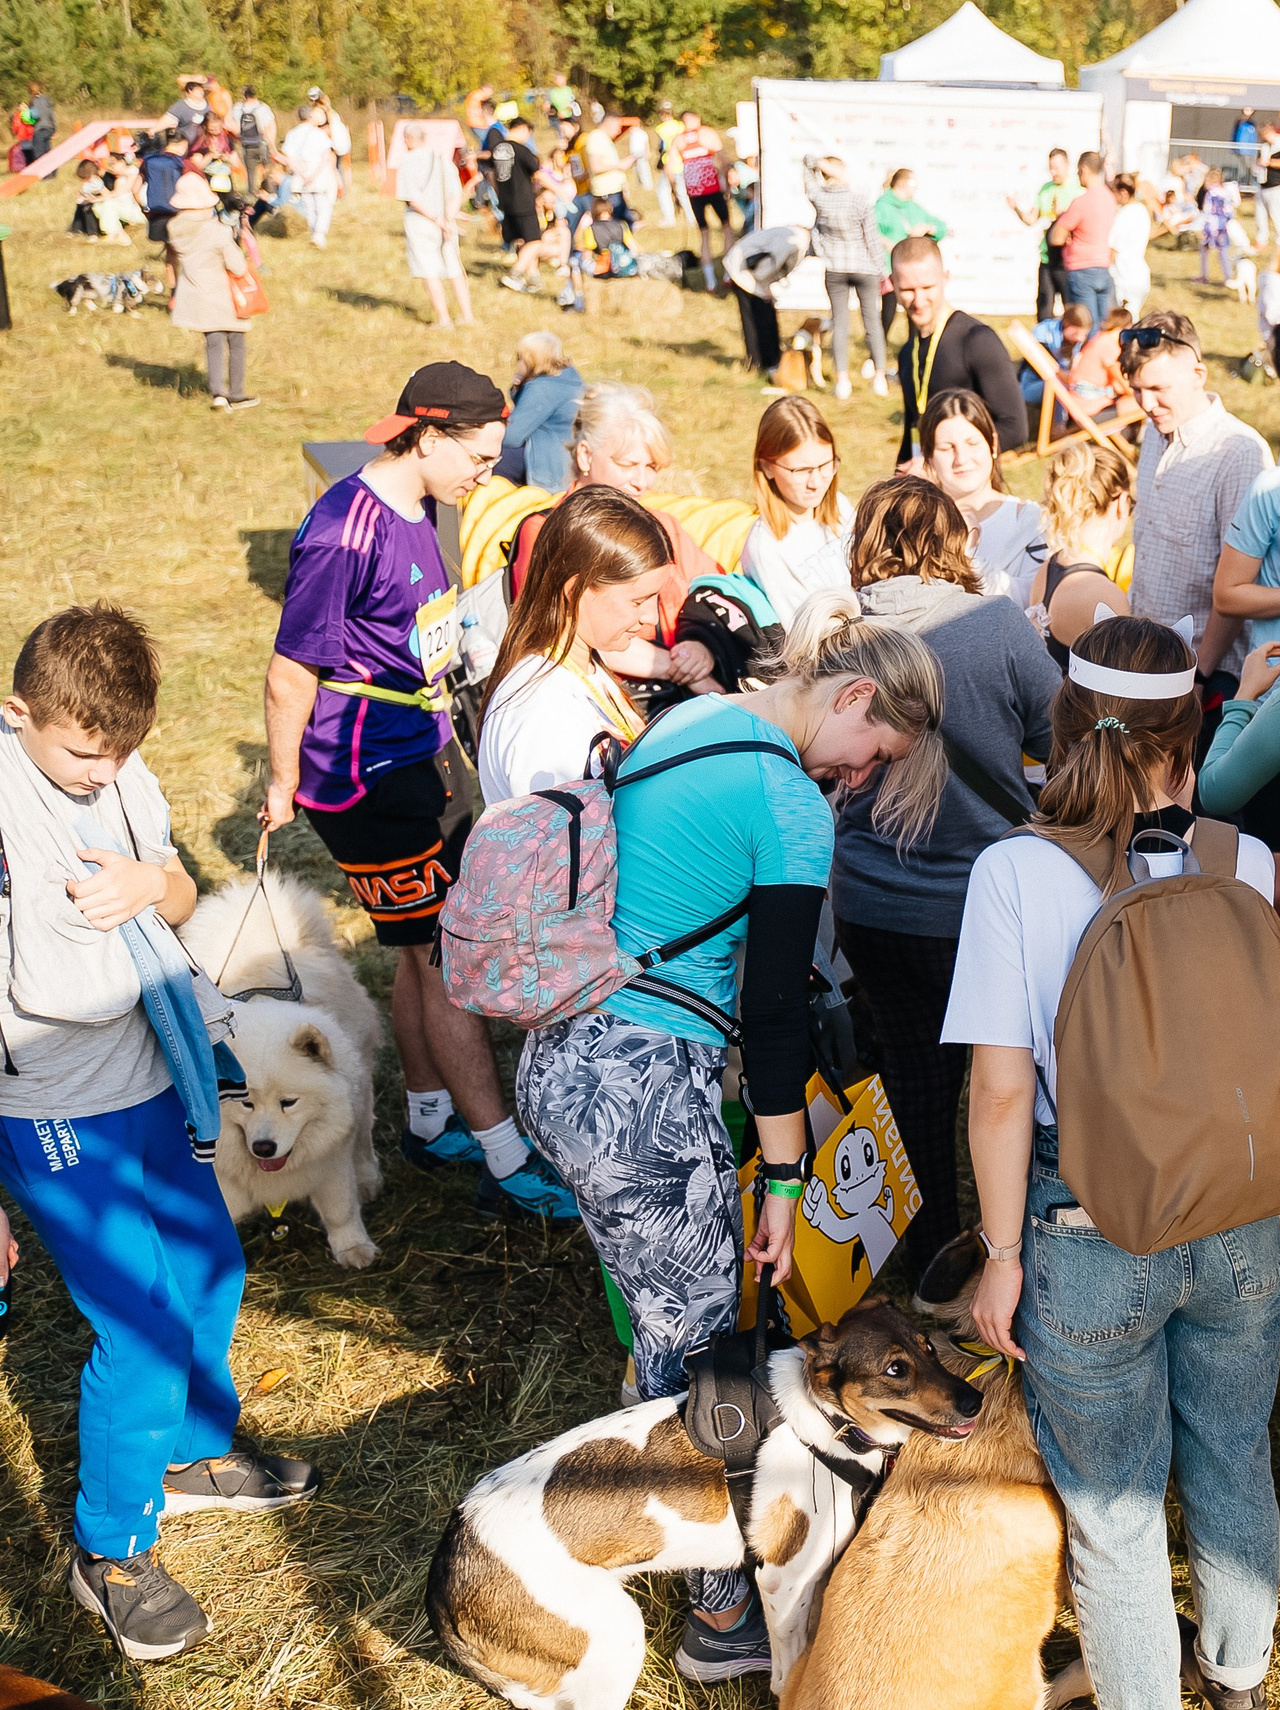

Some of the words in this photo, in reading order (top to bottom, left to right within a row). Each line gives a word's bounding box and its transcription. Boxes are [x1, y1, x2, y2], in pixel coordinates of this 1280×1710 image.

[427, 621, 450, 658] 220
[348, 859, 453, 906] NASA
[33, 1119, 64, 1172] MARKET
[867, 1073, 924, 1221] билайн
